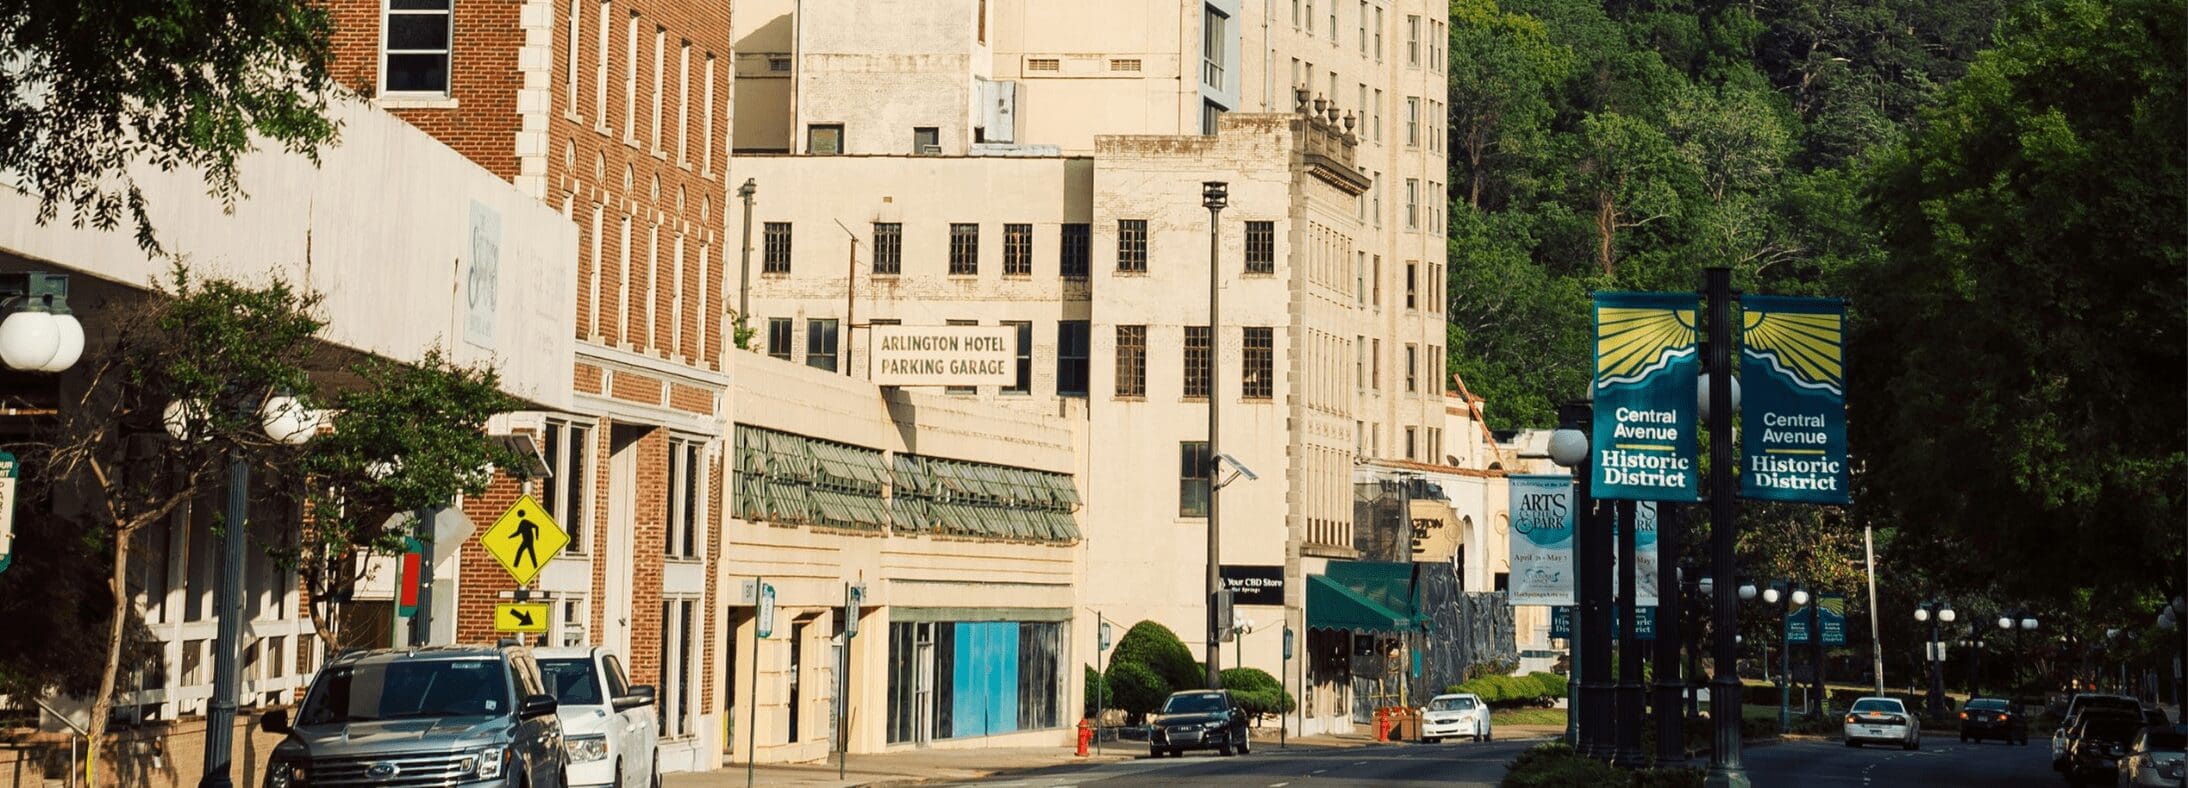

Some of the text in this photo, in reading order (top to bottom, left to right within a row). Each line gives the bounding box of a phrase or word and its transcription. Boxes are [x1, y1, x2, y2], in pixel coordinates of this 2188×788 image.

[881, 335, 1006, 351] ARLINGTON HOTEL
[881, 358, 1005, 375] PARKING GARAGE
[1616, 407, 1676, 424] Central
[1764, 412, 1825, 427] Central
[1614, 423, 1678, 440] Avenue
[1763, 428, 1827, 444] Avenue
[1601, 450, 1689, 470] Historic
[1751, 455, 1840, 474] Historic
[1603, 467, 1686, 488] District
[1755, 473, 1837, 491] District
[1520, 493, 1567, 518] ARTS
[1533, 517, 1565, 529] PARK
[1636, 519, 1654, 532] RK
[1514, 554, 1532, 562] April
[1227, 577, 1283, 588] Your CBD Store
